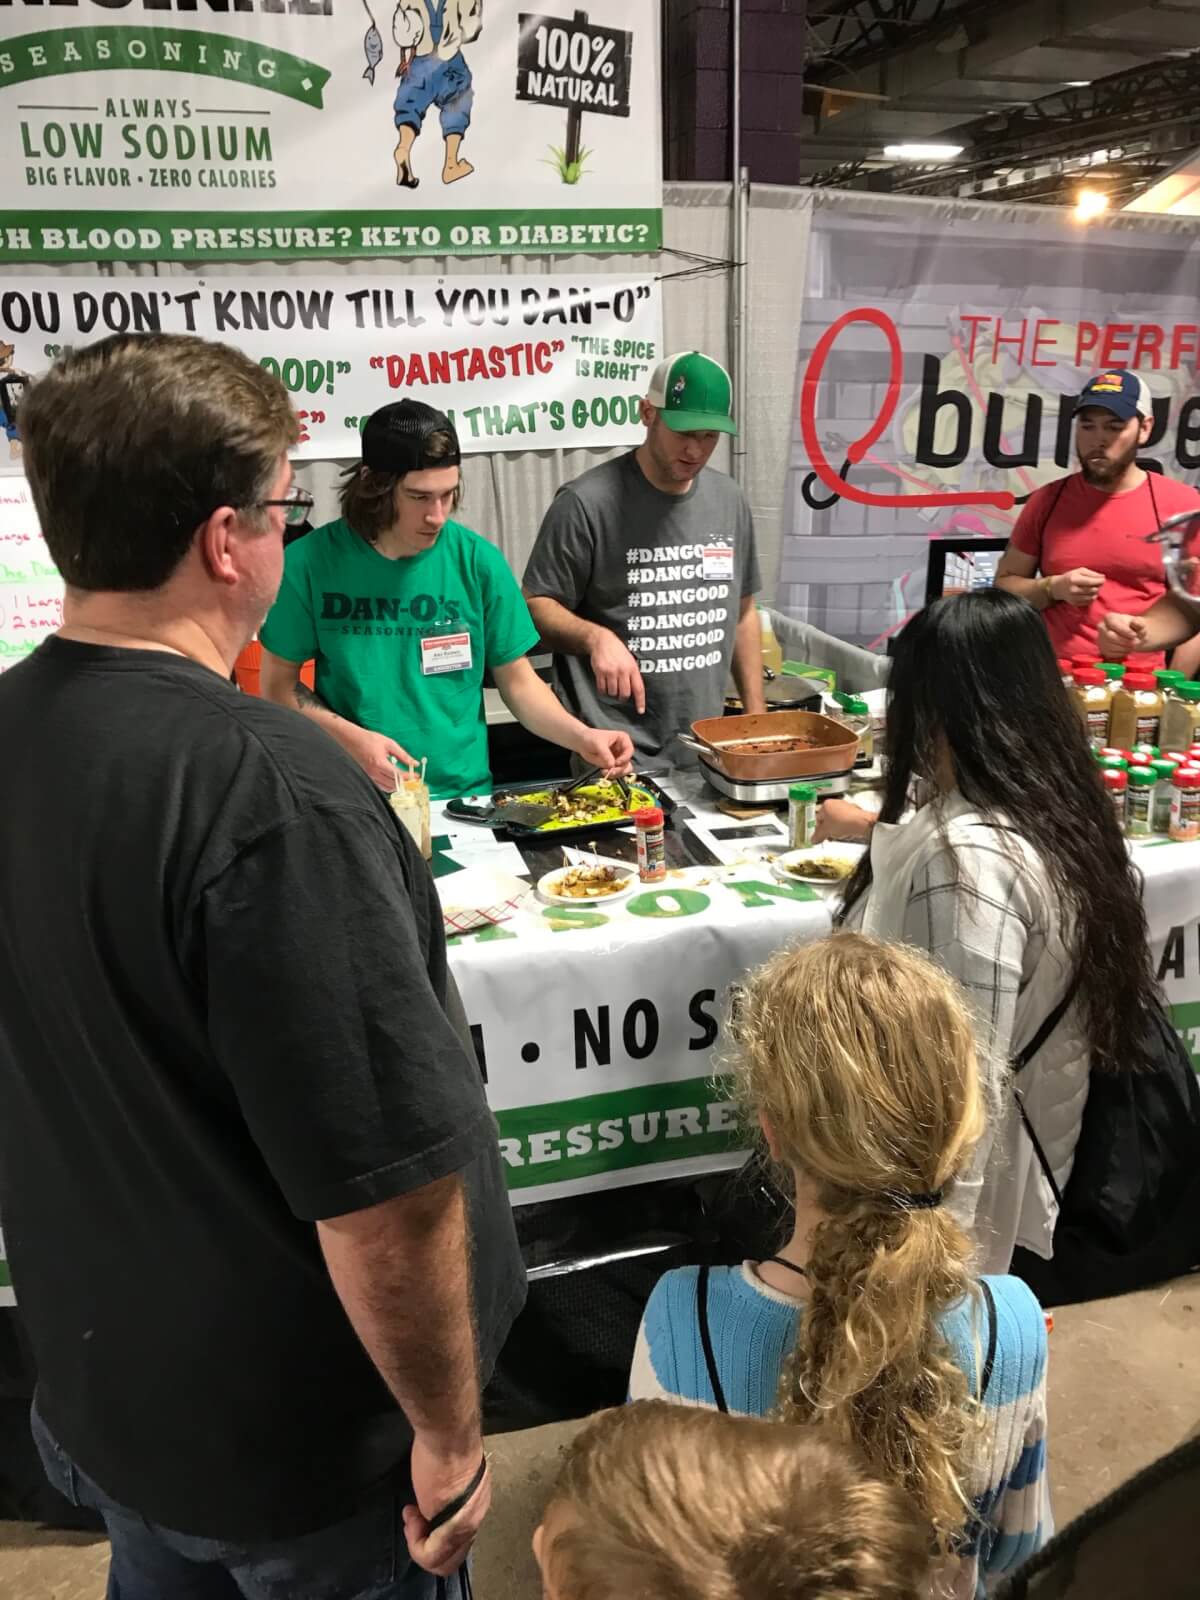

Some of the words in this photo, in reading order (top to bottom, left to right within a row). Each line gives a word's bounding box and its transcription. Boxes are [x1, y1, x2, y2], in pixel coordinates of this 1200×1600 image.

[0, 40, 276, 78] SEASONING
[536, 25, 615, 78] 100%
[527, 72, 619, 107] NATURAL
[106, 98, 192, 118] ALWAYS
[20, 121, 103, 158] LOW
[121, 124, 273, 161] SODIUM
[26, 167, 57, 186] BIG
[64, 167, 131, 186] FLAVOR
[150, 168, 192, 188] ZERO
[198, 169, 277, 188] CALORIES
[41, 228, 161, 249] BLOOD
[171, 226, 352, 248] PRESSURE?
[361, 227, 441, 247] KETO
[450, 226, 492, 247] OR
[500, 224, 649, 245] DIABETIC?
[1, 291, 60, 333] OU
[73, 290, 201, 333] DON'T
[213, 290, 334, 330] KNOW
[346, 289, 426, 328] TILL
[436, 288, 509, 327] YOU
[614, 338, 655, 360] SPICE
[960, 315, 1061, 367] THE
[1075, 321, 1200, 370] PERF
[576, 360, 590, 377] IS
[463, 399, 565, 437] THAT'S
[626, 542, 727, 564] #DANGO
[26, 595, 63, 612] Larg
[628, 584, 729, 607] #DANGOOD
[12, 616, 26, 629] 2
[627, 608, 727, 630] #DANGOOD
[628, 628, 725, 651] #DANGOOD
[639, 650, 722, 673] DANGOOD
[573, 998, 659, 1070] NO
[498, 1101, 738, 1168] RESSURE
